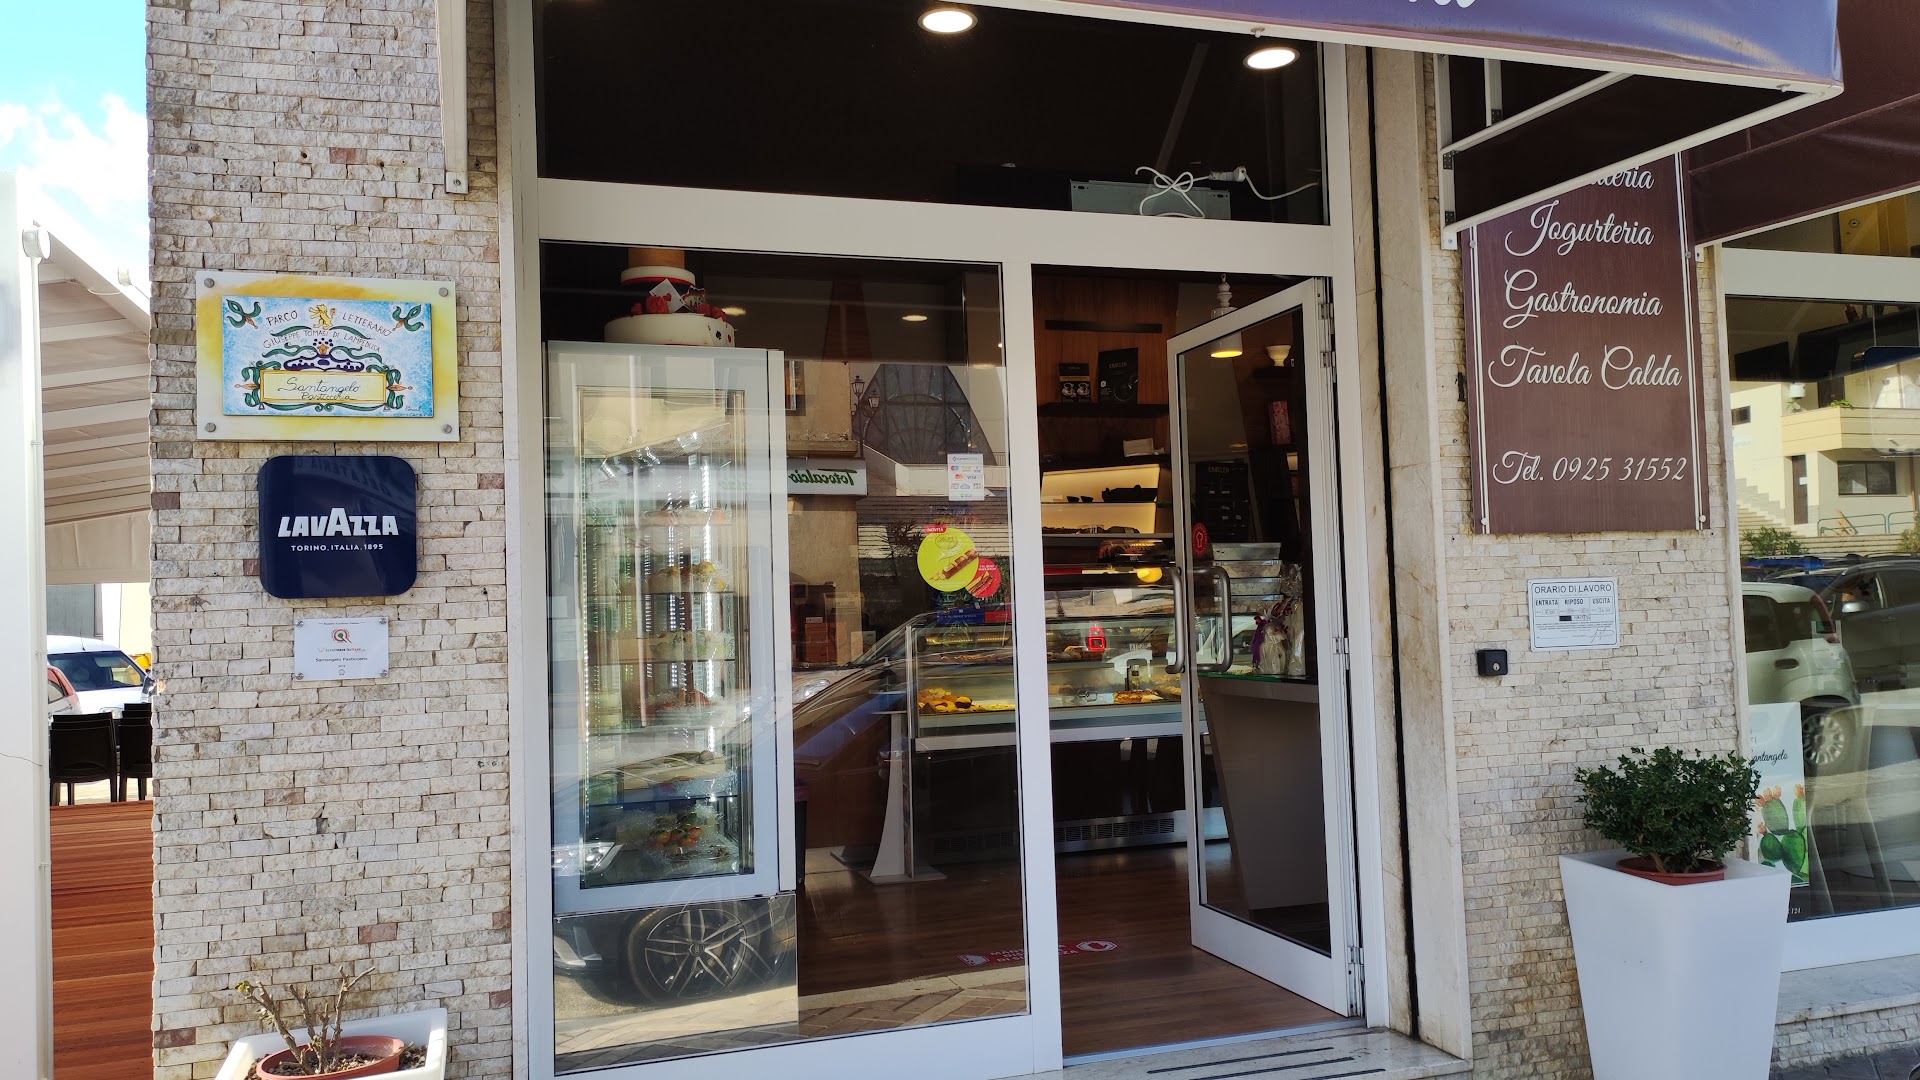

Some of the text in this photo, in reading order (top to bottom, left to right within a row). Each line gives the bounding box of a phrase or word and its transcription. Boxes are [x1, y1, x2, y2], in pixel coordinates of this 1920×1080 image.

[1503, 269, 1663, 329] Gastronomia
[266, 310, 393, 337] PARCO LETTERARIO
[262, 332, 301, 349] GIUSEPPE
[304, 329, 329, 337] TOMASI
[343, 334, 381, 353] LAMPEDUSA
[1488, 344, 1682, 390] Tavola Calda
[277, 376, 360, 393] Santangelo
[1493, 450, 1688, 485] Tel. 0925 31552
[278, 507, 399, 537] LAVAZZA
[364, 543, 384, 551] 1895
[1534, 586, 1567, 594] ORARIO
[1578, 584, 1612, 593] LAVORO
[1592, 597, 1610, 605] USCITA
[1751, 749, 1788, 766] antangelo
